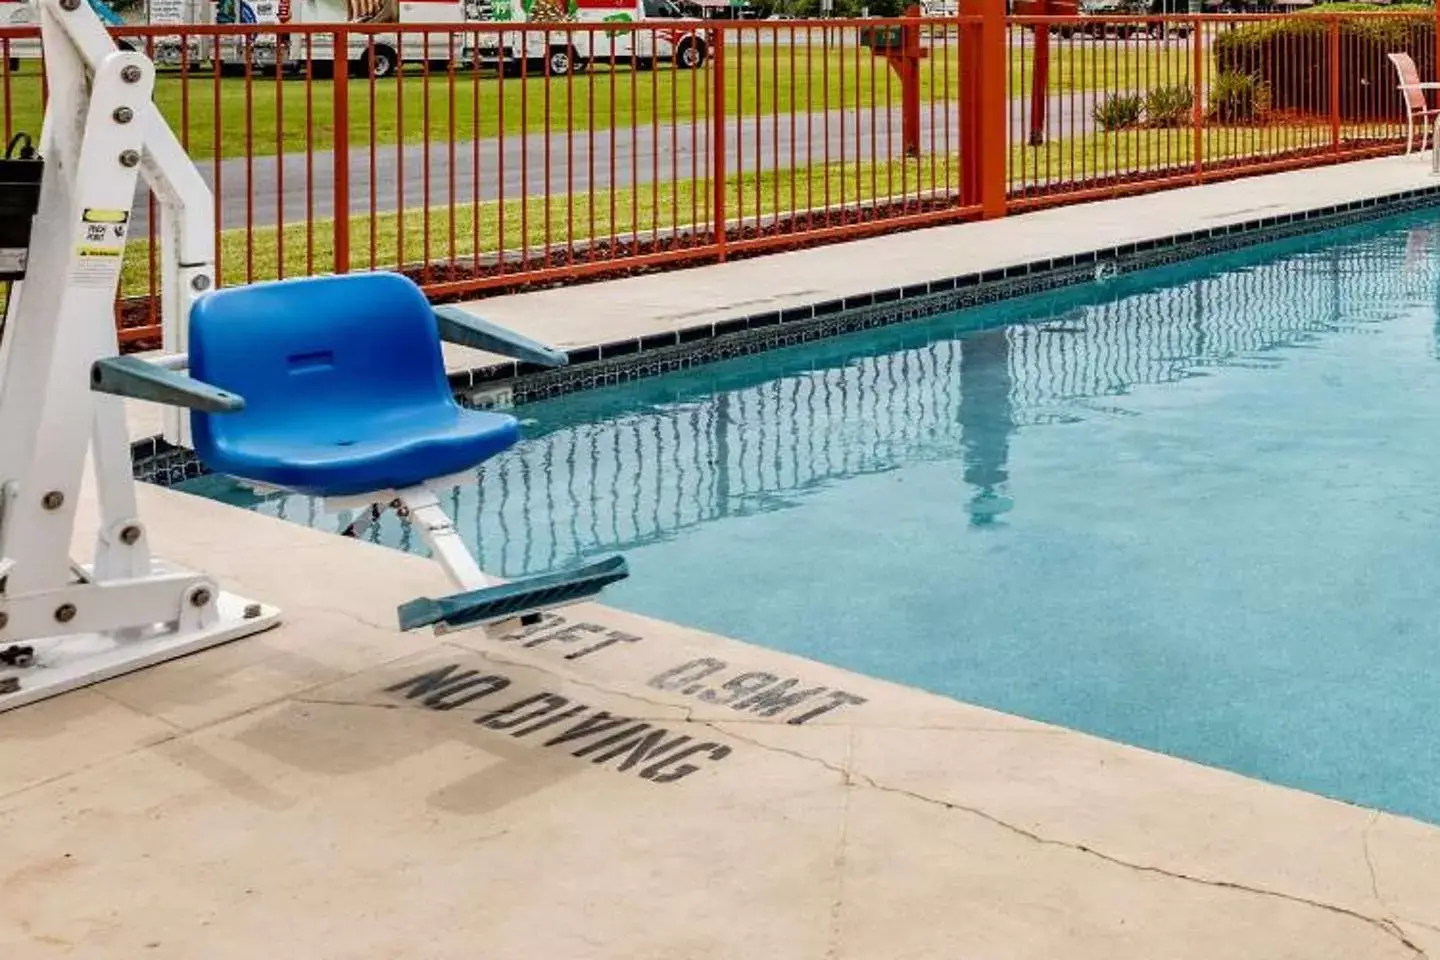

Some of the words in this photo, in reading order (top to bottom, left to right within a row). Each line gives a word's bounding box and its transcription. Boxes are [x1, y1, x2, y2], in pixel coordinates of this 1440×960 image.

[385, 664, 512, 711] NO
[474, 692, 732, 783] DIVING
[646, 657, 868, 725] 0.9MT
